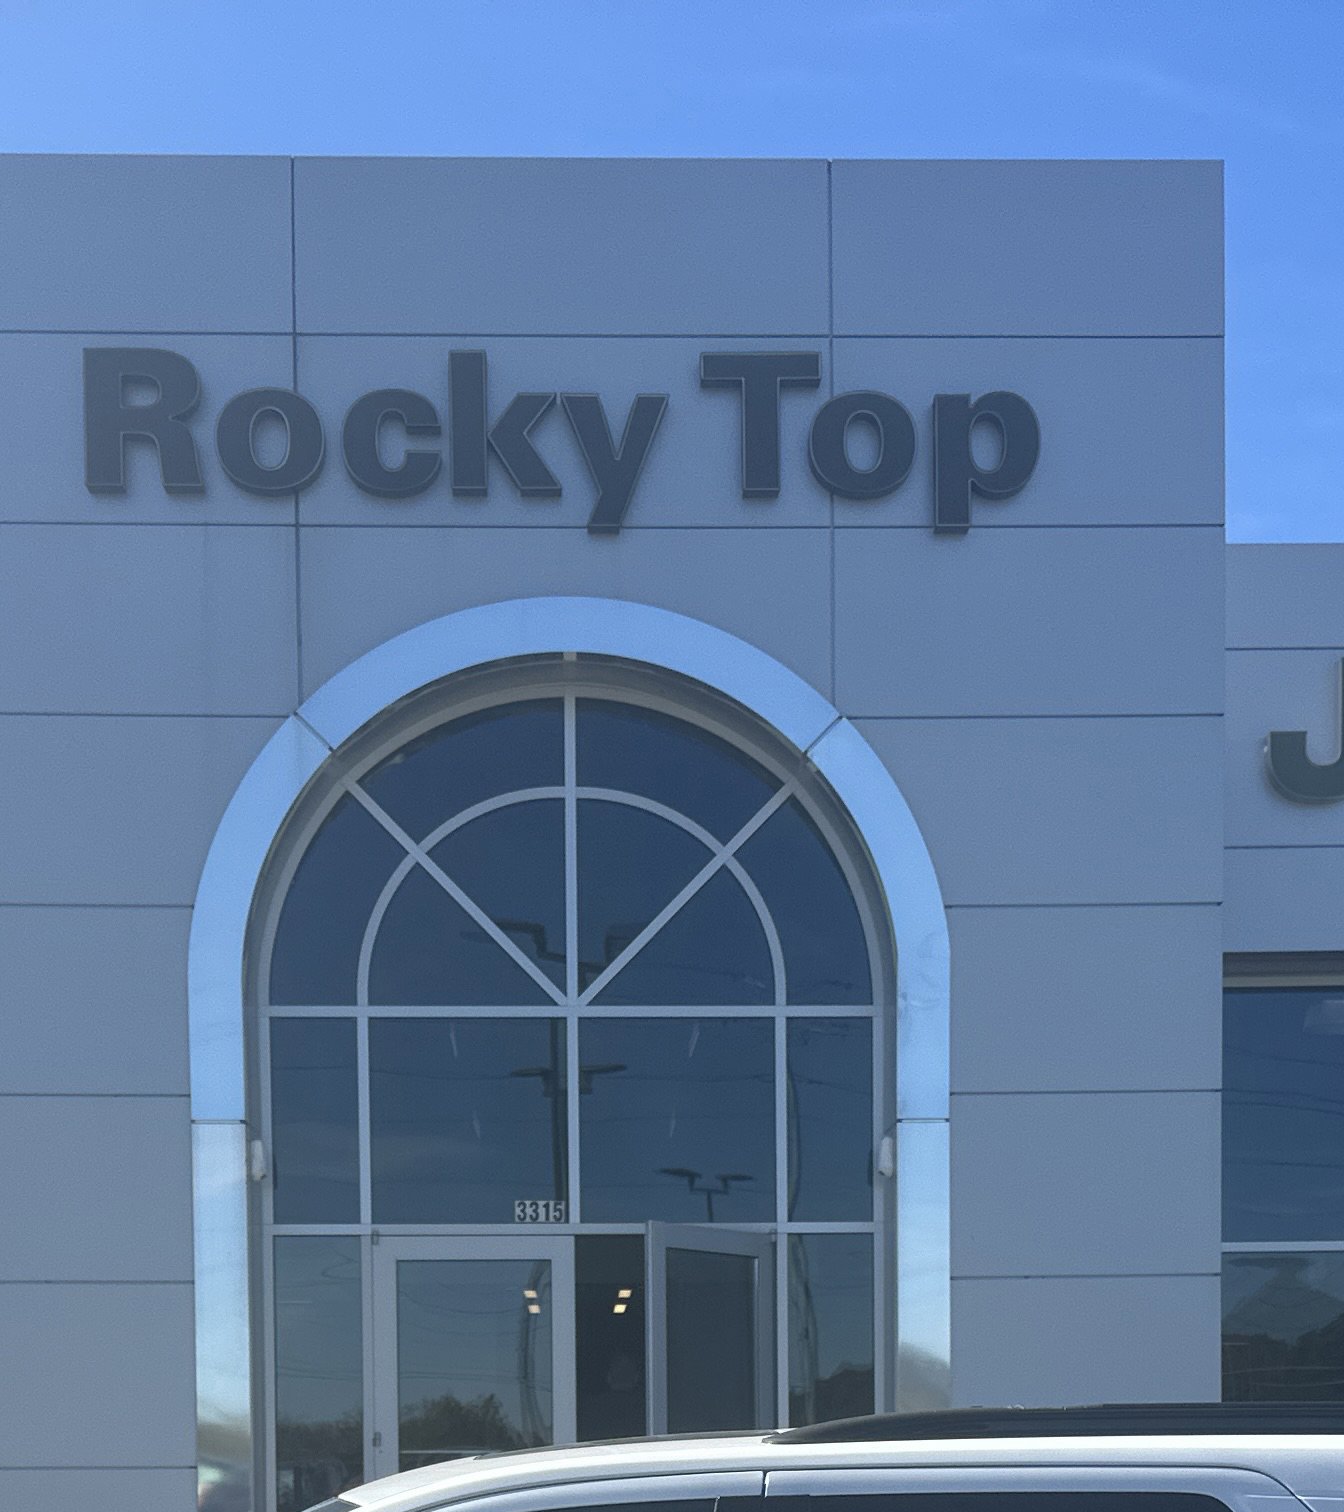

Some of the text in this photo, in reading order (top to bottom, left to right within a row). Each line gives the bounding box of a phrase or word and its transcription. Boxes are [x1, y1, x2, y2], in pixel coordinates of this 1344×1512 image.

[81, 347, 1041, 534] Rocky Top
[516, 1201, 564, 1221] 3315
